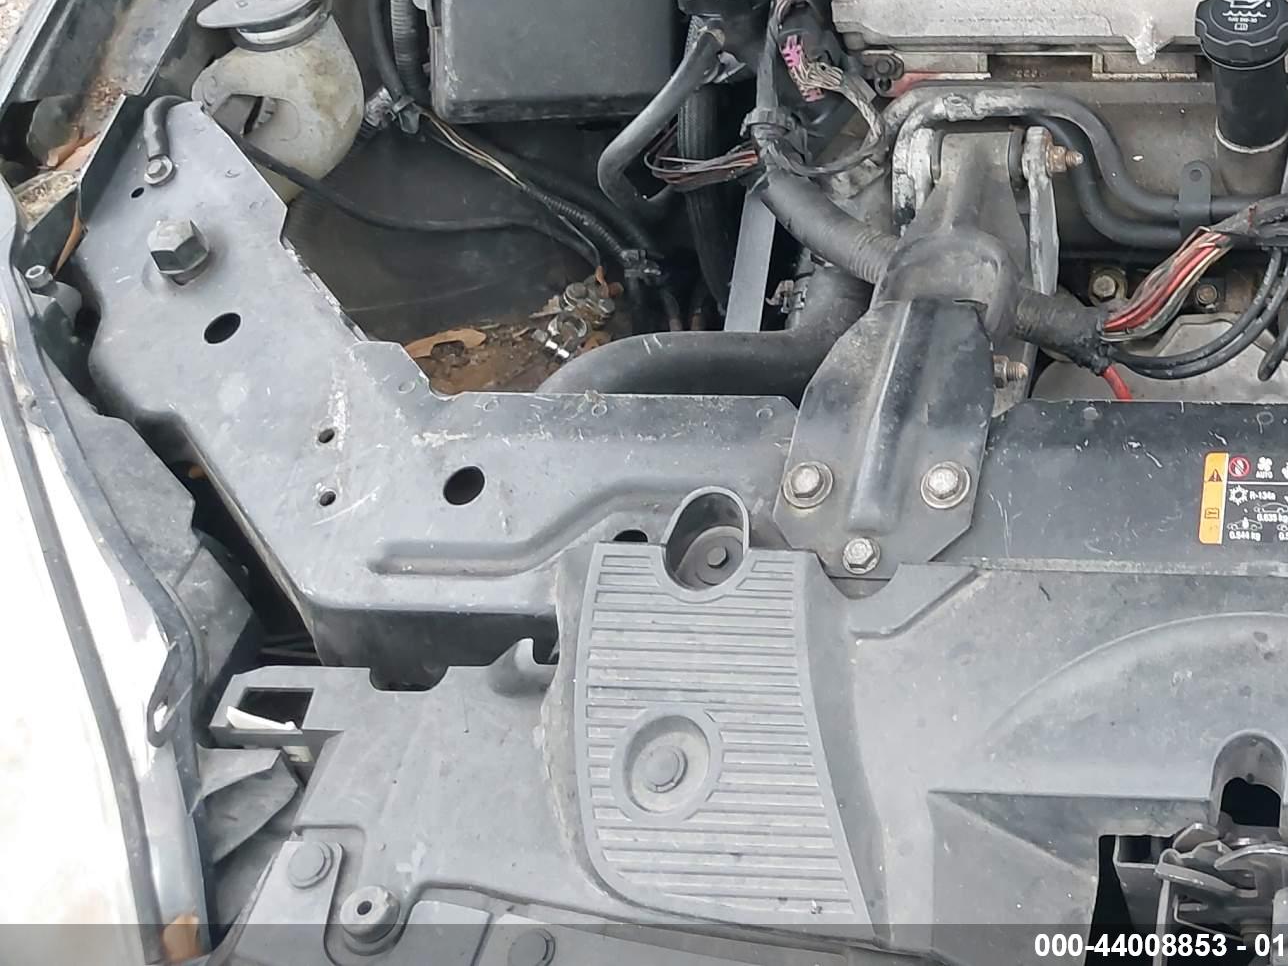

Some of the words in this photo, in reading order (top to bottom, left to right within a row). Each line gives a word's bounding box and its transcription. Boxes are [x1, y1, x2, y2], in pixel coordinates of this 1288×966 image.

[1256, 471, 1273, 479] AUTO
[1278, 512, 1288, 523] kg
[1251, 531, 1261, 541] kg
